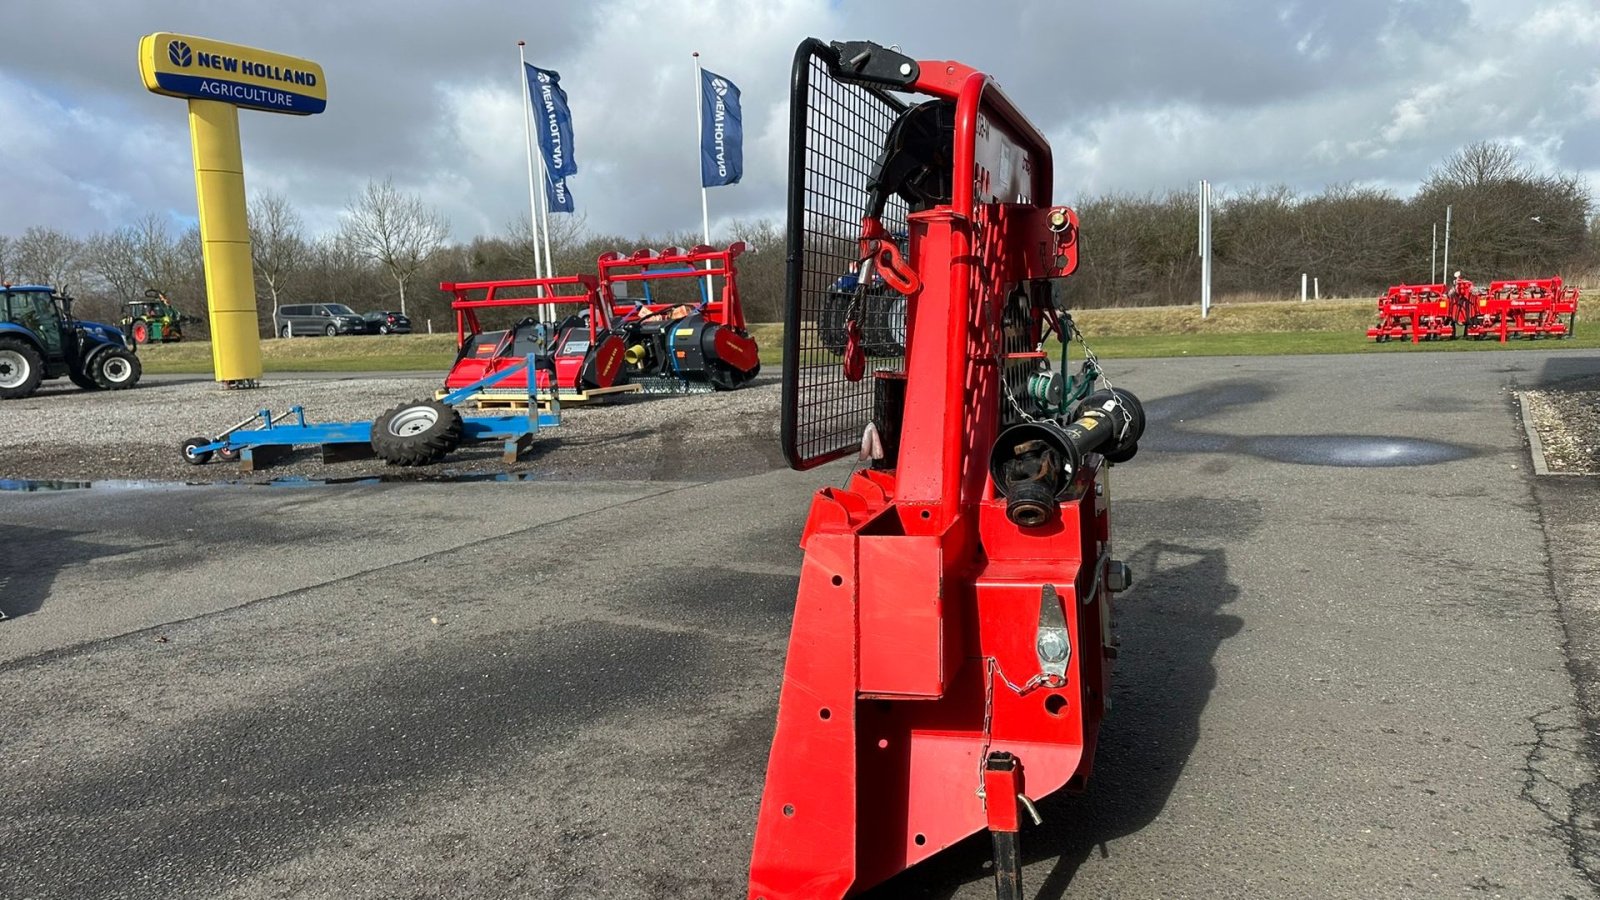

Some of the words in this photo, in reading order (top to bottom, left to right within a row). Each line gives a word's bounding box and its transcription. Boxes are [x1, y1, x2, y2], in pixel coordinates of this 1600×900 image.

[197, 51, 238, 73] NEW
[241, 60, 317, 87] HOLLAND
[200, 80, 293, 107] AGRICULTURE
